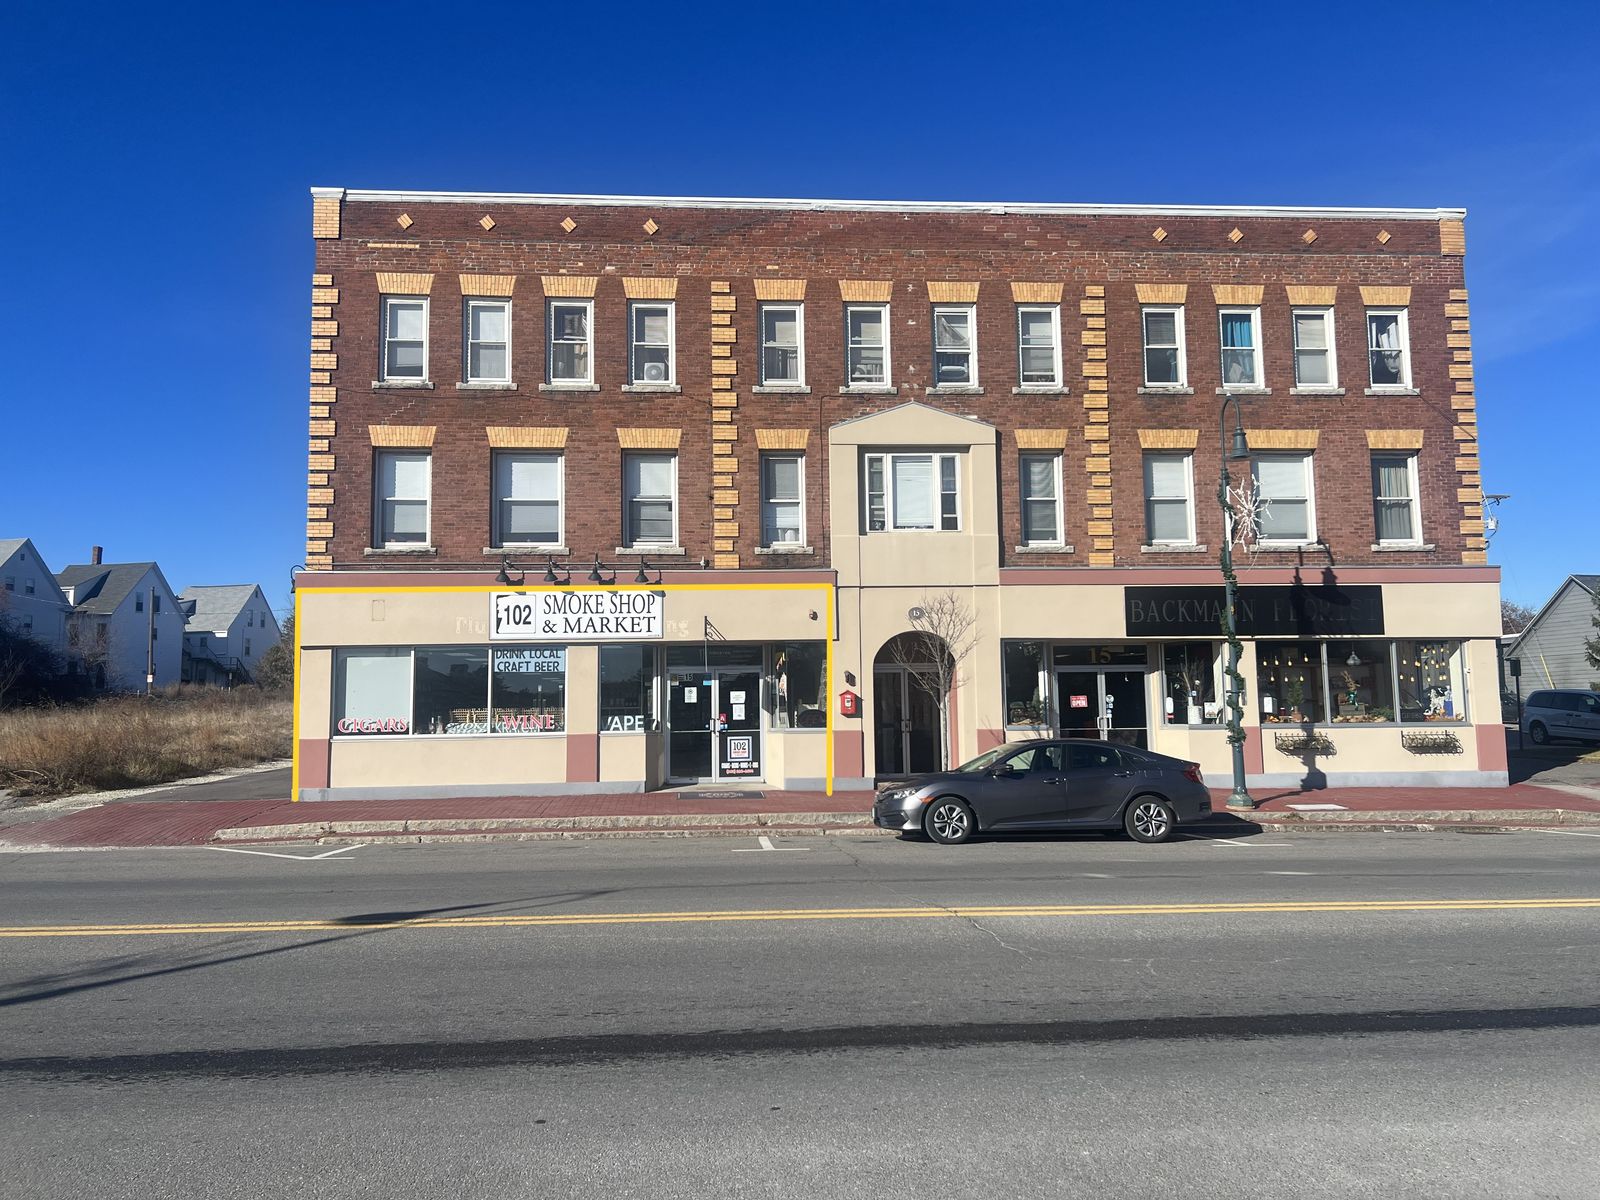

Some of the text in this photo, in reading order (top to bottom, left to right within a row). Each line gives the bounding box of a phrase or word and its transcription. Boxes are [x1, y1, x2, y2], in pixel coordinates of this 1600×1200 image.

[543, 593, 656, 615] SMOKE SHOP
[1130, 599, 1256, 624] BACKMAN
[504, 604, 532, 626] 102
[456, 616, 488, 634] Plu
[542, 616, 656, 634] & MARKET
[495, 648, 561, 660] DRINK LOCAL
[1090, 646, 1111, 664] 15
[497, 661, 560, 672] CRAFT BEER
[337, 716, 408, 733] CIGARS
[502, 714, 555, 730] WINE
[733, 741, 747, 751] 102
